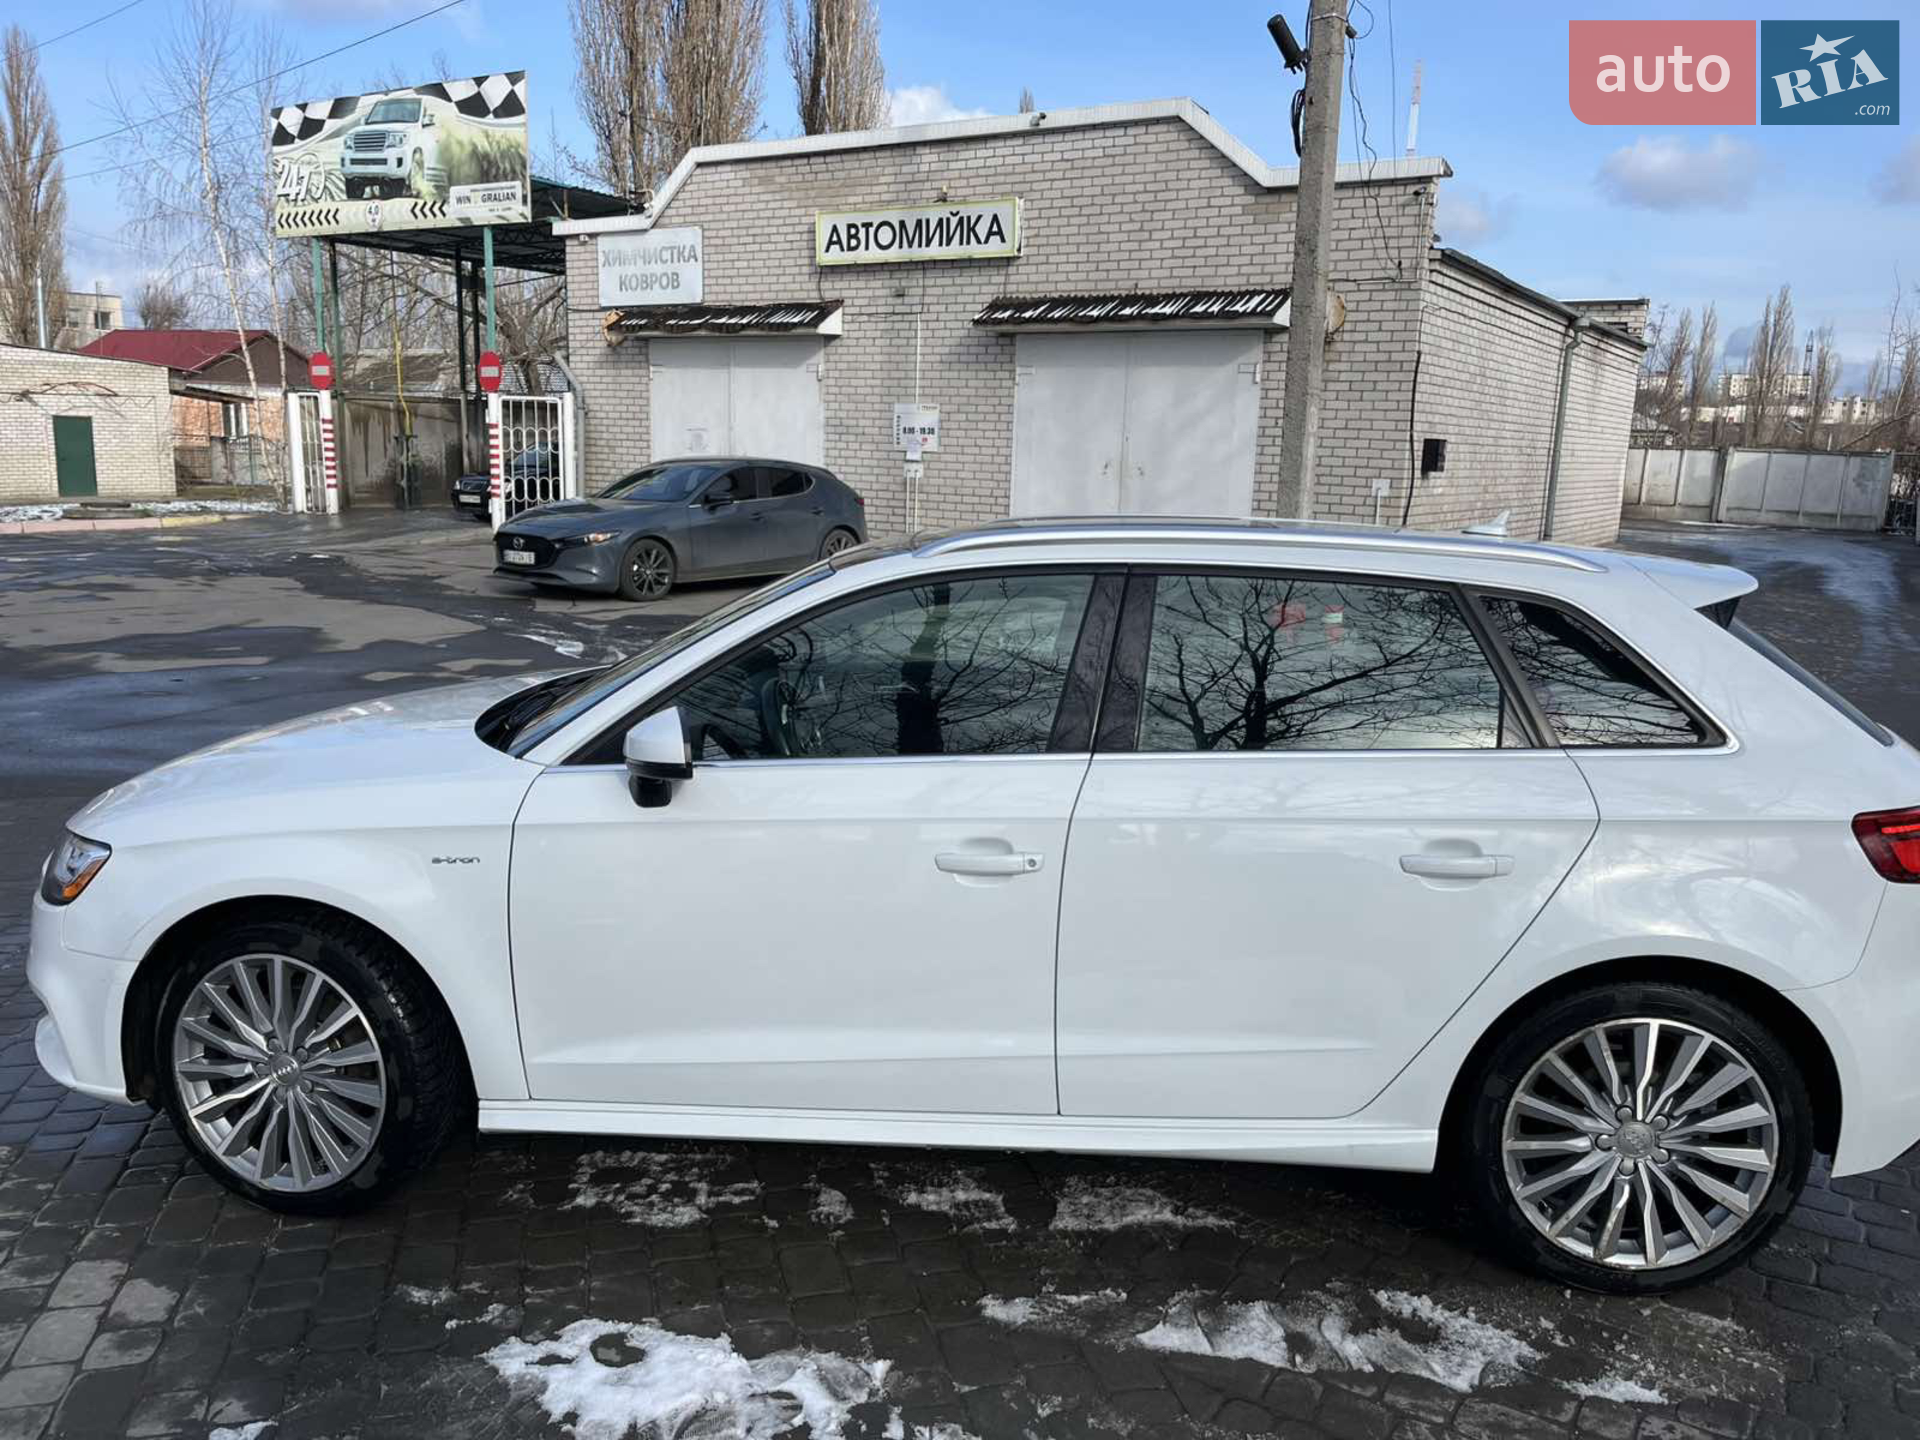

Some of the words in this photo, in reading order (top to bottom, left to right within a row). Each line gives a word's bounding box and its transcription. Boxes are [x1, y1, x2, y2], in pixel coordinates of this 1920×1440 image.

[825, 211, 1006, 253] АВТОМИЙКА
[602, 245, 698, 268] ХИМЧИСТКА
[619, 271, 681, 292] КОВРОВ
